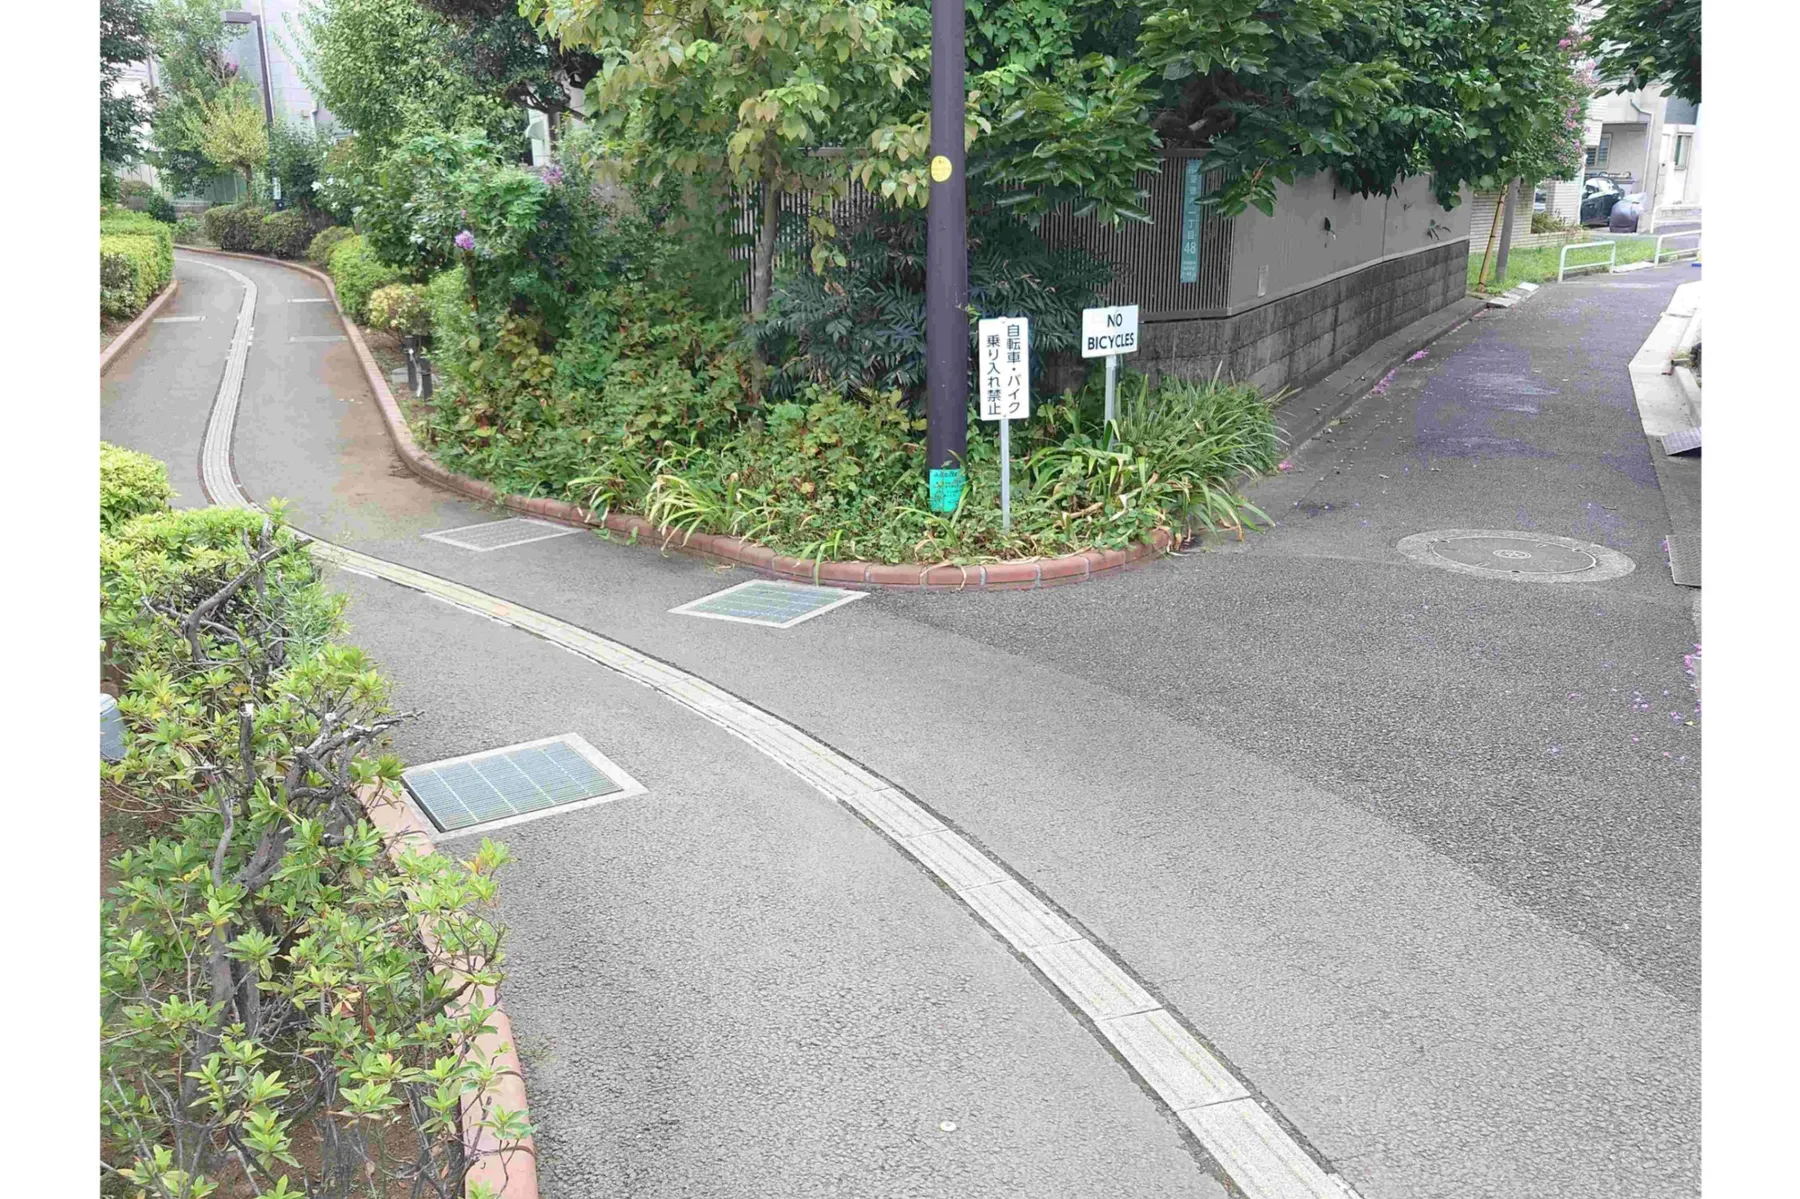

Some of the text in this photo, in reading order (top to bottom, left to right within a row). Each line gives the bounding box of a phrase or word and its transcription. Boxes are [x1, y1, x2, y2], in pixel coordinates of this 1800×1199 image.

[1184, 242, 1196, 254] 48
[1107, 313, 1123, 328] NO
[1087, 332, 1135, 350] BICYCLES
[987, 335, 1001, 415] 乗り入れ禁止
[1007, 324, 1021, 414] 自転車・バイク
